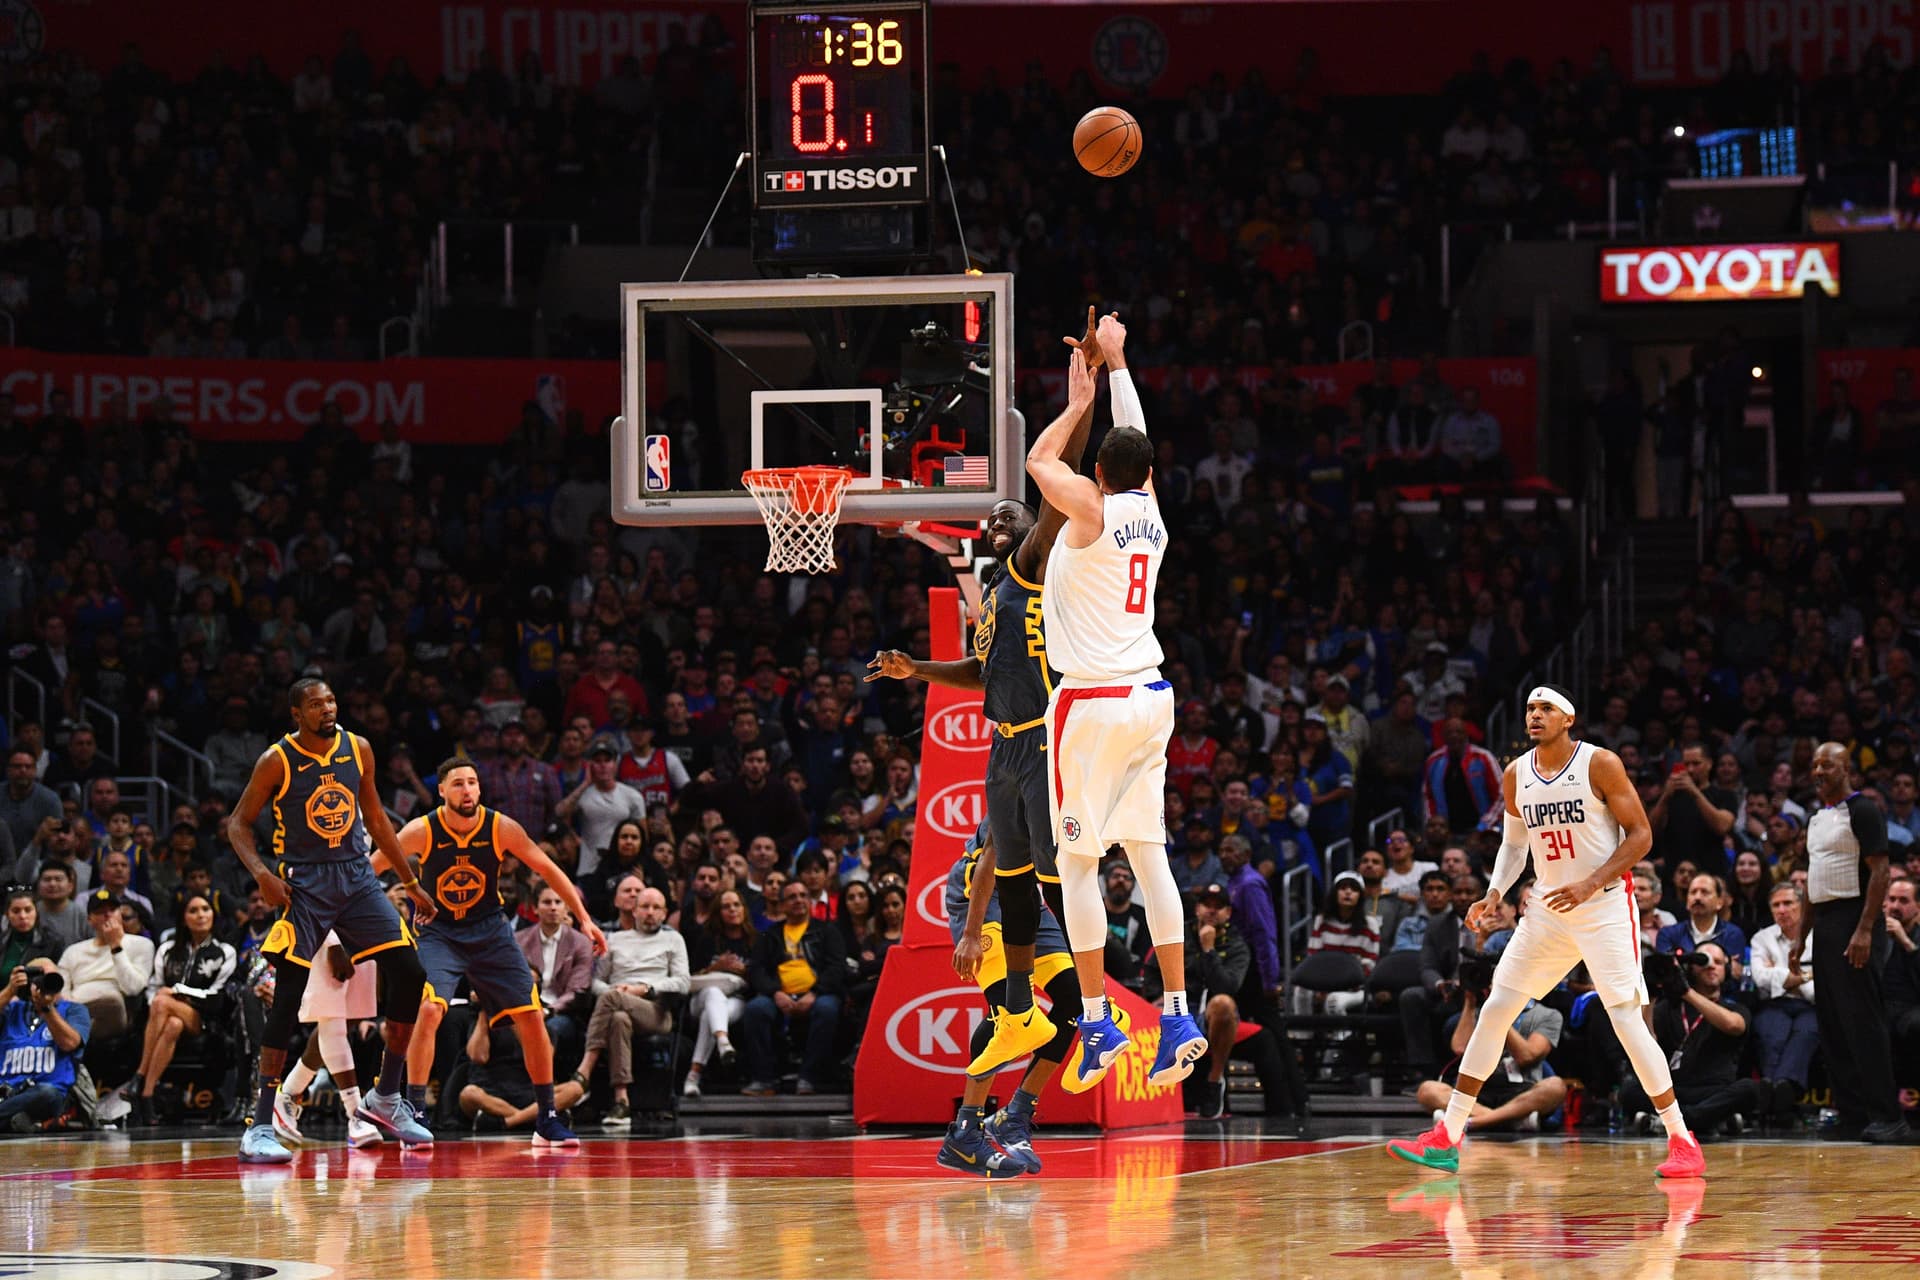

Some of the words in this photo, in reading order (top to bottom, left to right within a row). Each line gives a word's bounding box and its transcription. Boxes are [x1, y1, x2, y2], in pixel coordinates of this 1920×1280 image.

[825, 21, 903, 67] 1:36
[806, 166, 918, 191] TISSOT
[1604, 249, 1834, 296] TOYOTA
[1114, 518, 1163, 551] GALLINARI
[1125, 553, 1149, 614] 8
[323, 813, 344, 829] 35
[943, 793, 982, 828] KI
[1523, 798, 1585, 829] CLIPPERS
[1540, 829, 1575, 861] 34
[1, 1045, 56, 1076] PHOTO
